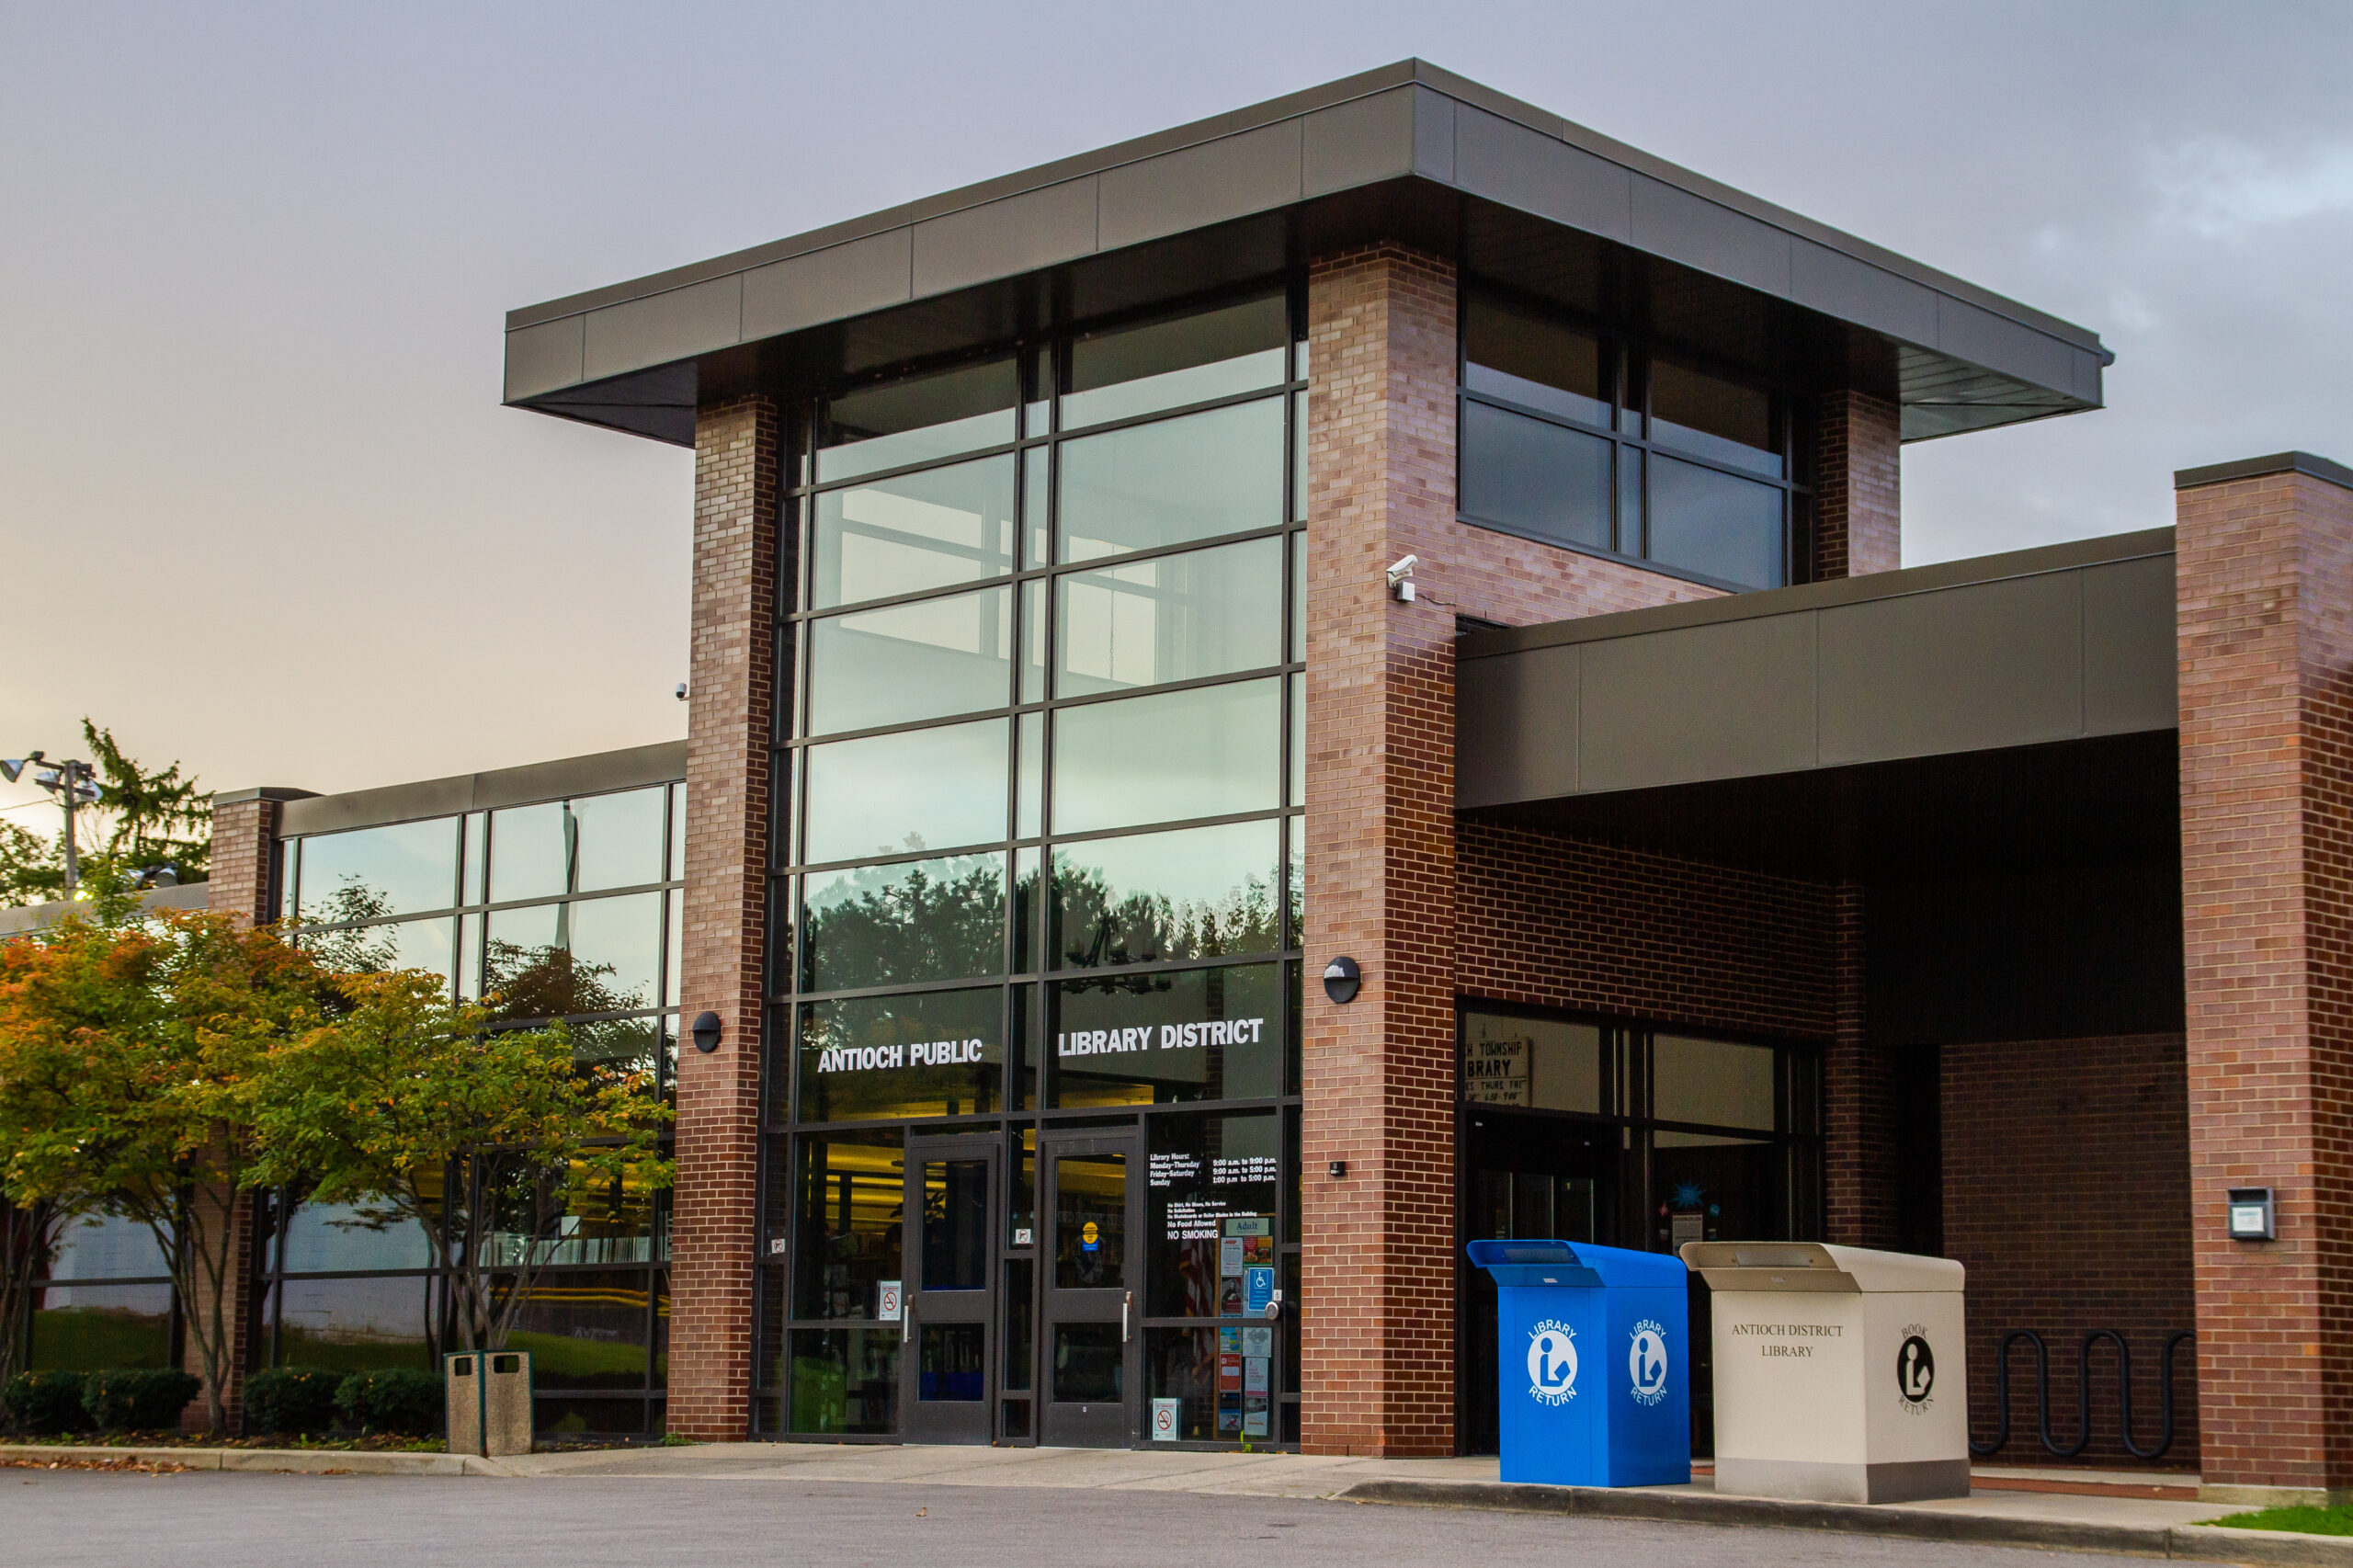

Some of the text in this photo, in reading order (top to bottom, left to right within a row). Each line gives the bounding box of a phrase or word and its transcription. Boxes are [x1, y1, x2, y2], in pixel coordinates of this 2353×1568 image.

[817, 1018, 1264, 1074] ANTIOCH PUBLIC LIBRARY DISTRICT
[1480, 1040, 1522, 1056] TOWNSHIP
[1467, 1059, 1510, 1077] BRARY
[1150, 1161, 1200, 1169] Monday-Thursday
[1150, 1169, 1195, 1178] Friday-Saturday
[1194, 1219, 1216, 1227] Allowed
[1236, 1221, 1257, 1231] Adult
[1167, 1229, 1219, 1240] NO SMOKING
[1528, 1319, 1577, 1340] LIBRARY
[1629, 1319, 1667, 1340] LIBRARY
[1732, 1324, 1844, 1336] ANTIOCH DISTRICT
[1901, 1323, 1928, 1339] BOOK
[1761, 1345, 1813, 1358] LIBRARY
[1529, 1384, 1577, 1407] RETURN
[1630, 1385, 1667, 1406] RETURN
[1898, 1394, 1935, 1415] RETURN
